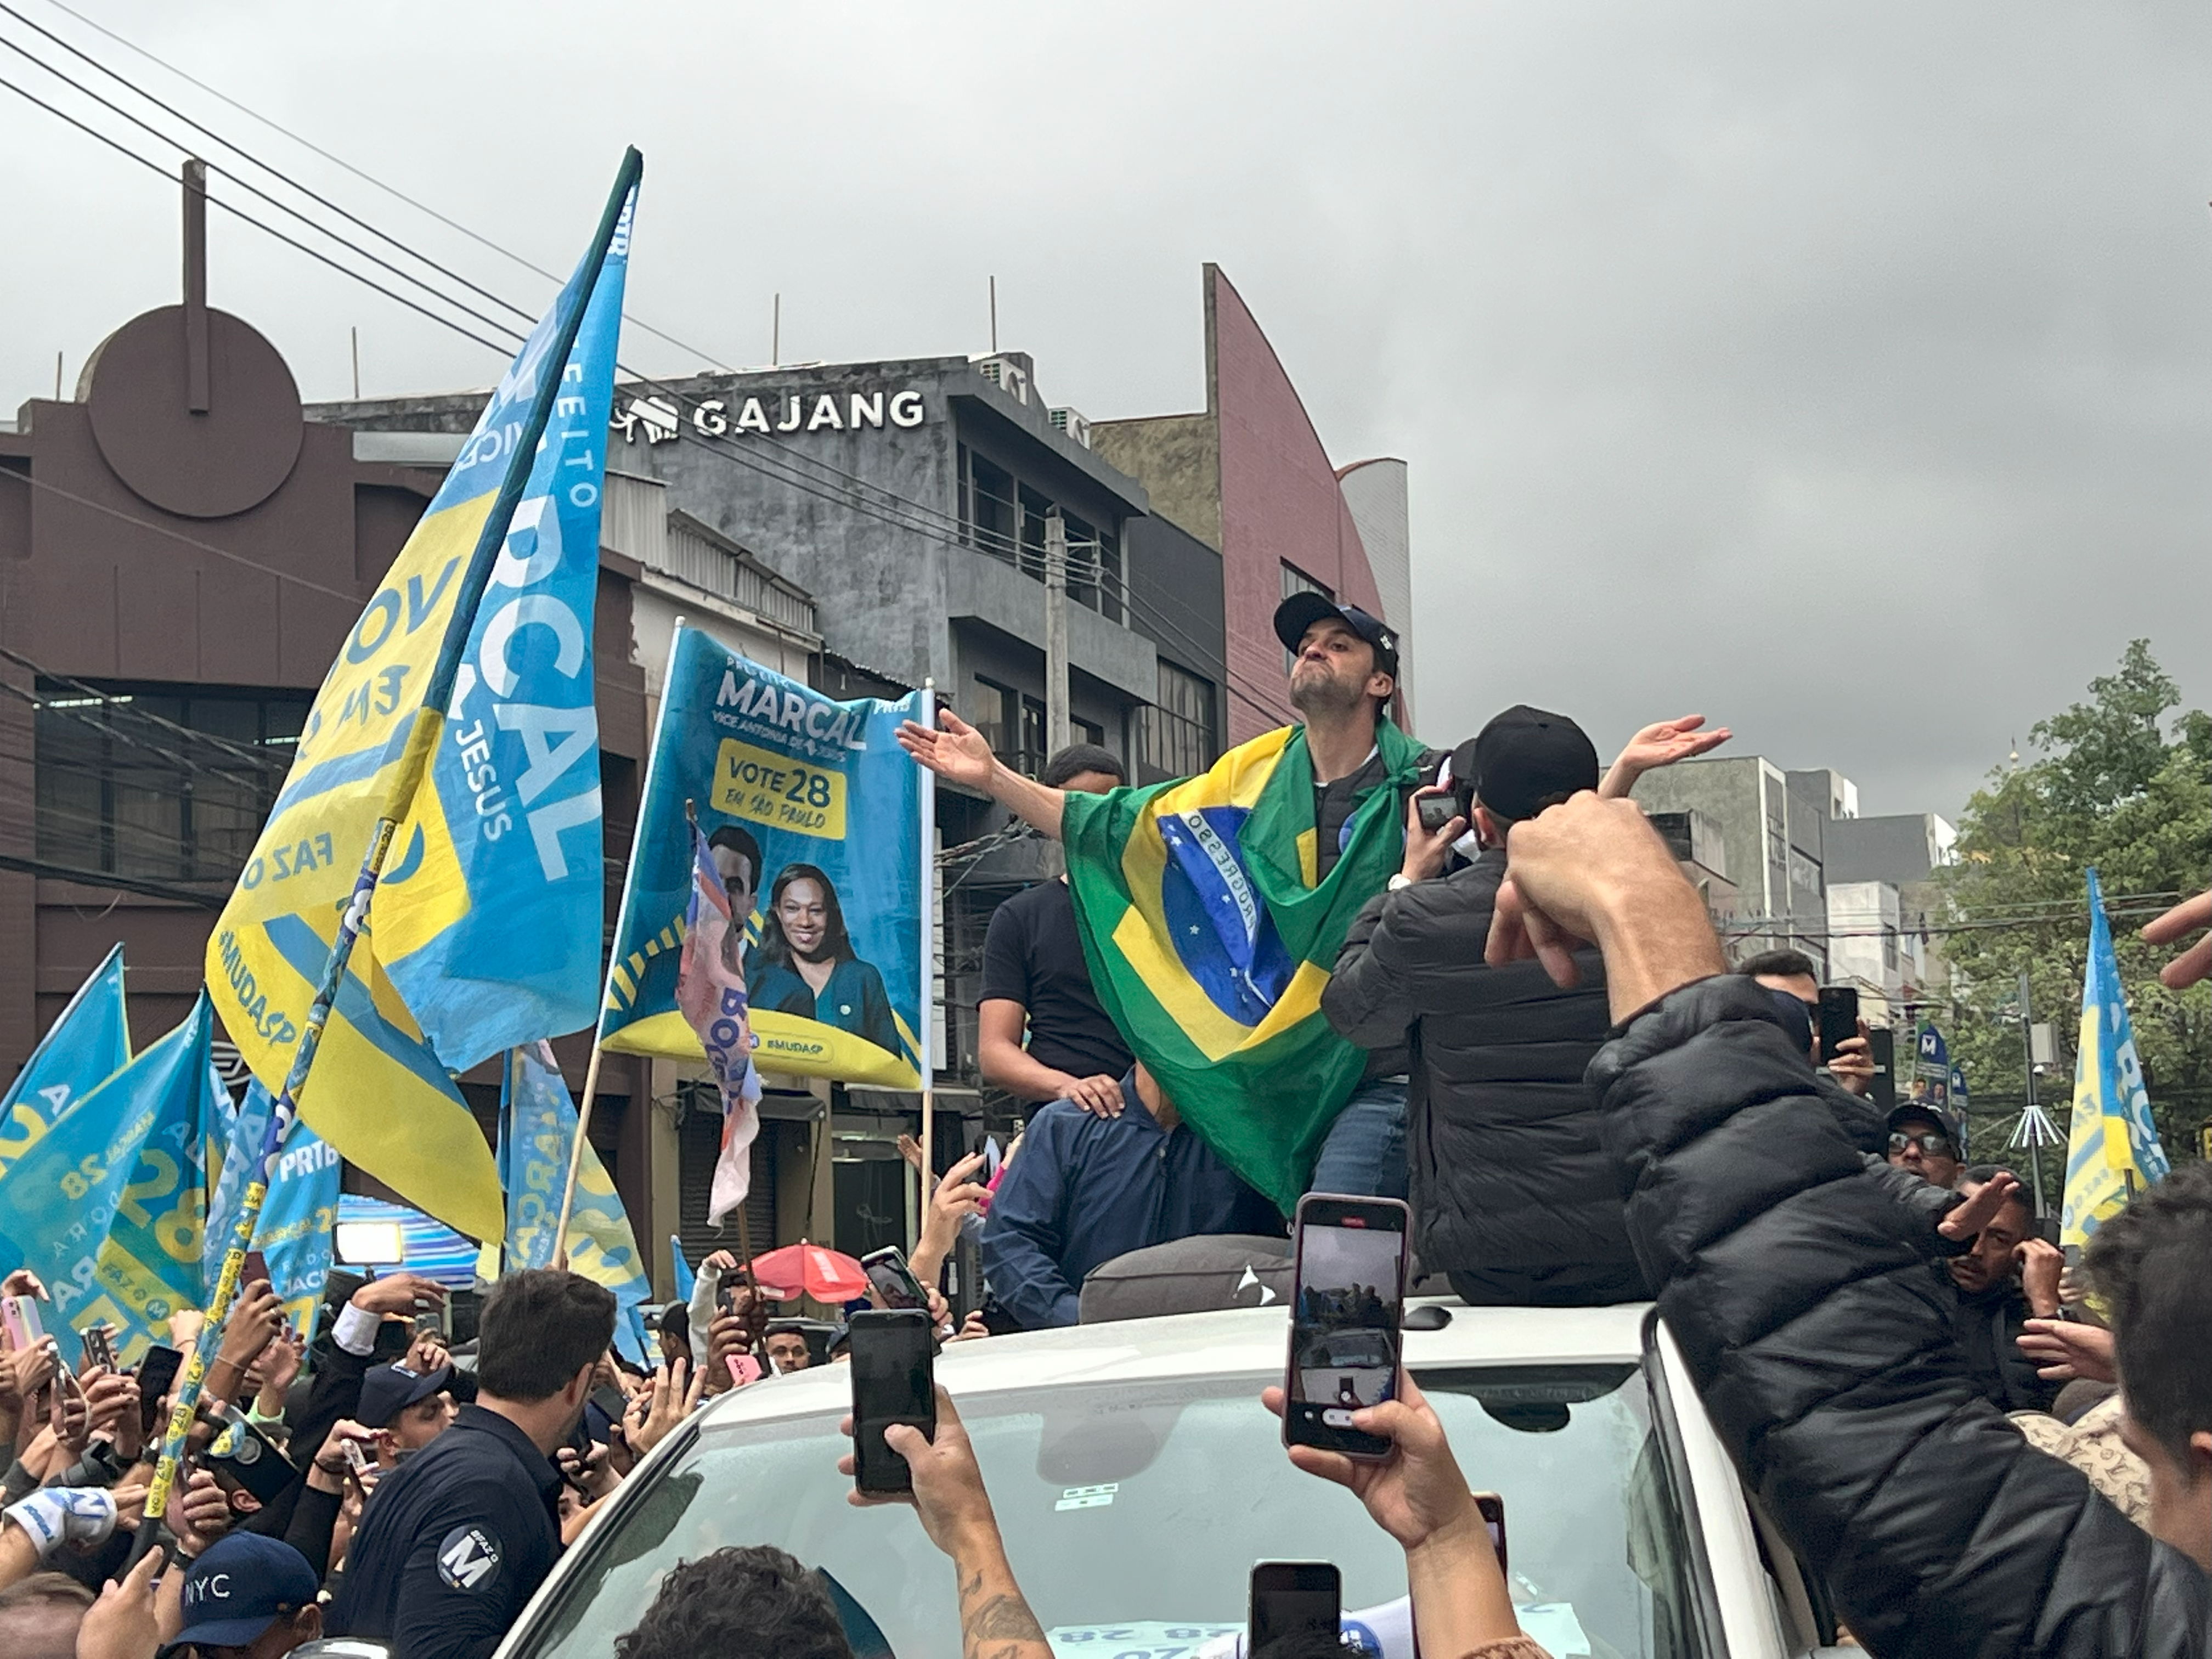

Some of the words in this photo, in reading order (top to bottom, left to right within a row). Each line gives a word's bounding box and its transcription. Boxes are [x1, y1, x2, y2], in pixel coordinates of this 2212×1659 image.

[693, 391, 923, 437] GAJANG
[456, 719, 512, 841] JESUS
[730, 757, 786, 793] VOTE
[786, 768, 831, 808] 28
[725, 788, 746, 806] EM
[778, 804, 826, 829] PAULO
[441, 1535, 492, 1588] M
[185, 1573, 230, 1606] NYC
